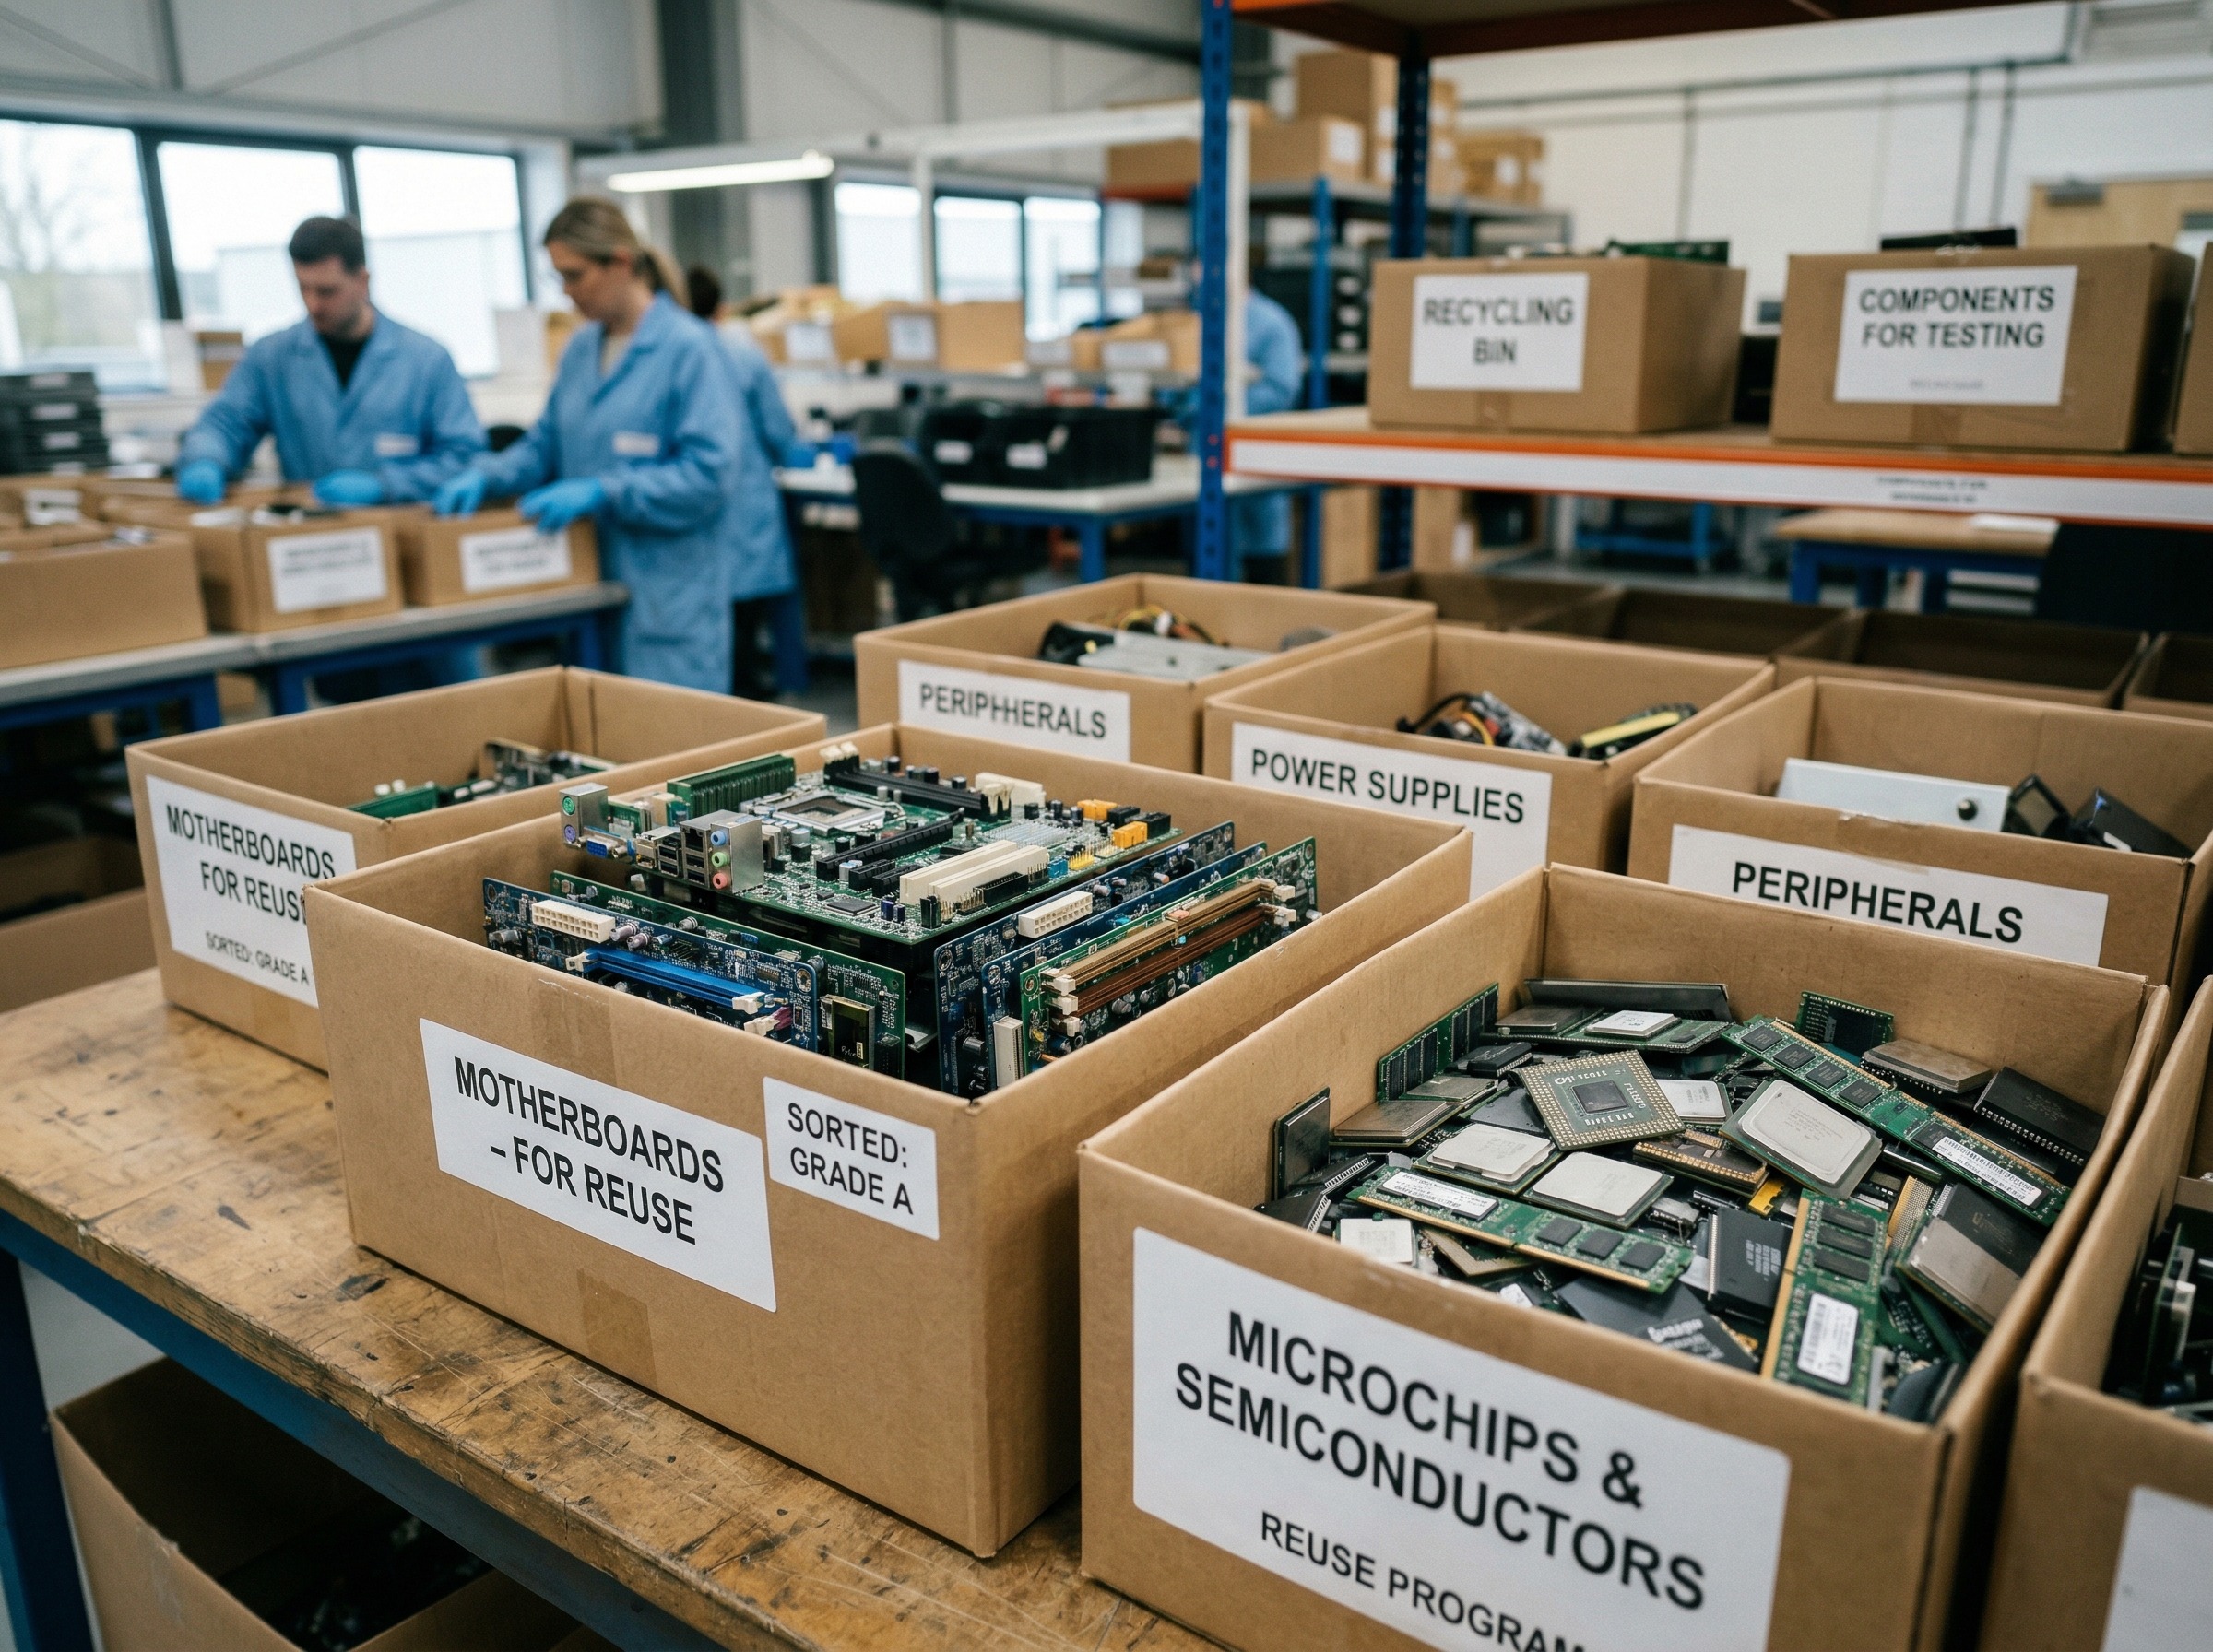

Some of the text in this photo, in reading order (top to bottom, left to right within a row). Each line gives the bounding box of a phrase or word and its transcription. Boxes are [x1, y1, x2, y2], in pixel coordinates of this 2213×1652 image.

[1423, 297, 1574, 326] RECYCLING
[1860, 286, 2055, 313] COMPONENTS
[1863, 323, 2045, 348] FOR TESTING
[1473, 338, 1517, 364] BIN
[1252, 749, 1523, 823] POWER SUPPLIES
[167, 804, 336, 879] MOTHERBOARDS
[200, 861, 307, 925] FOR REUS
[1733, 862, 2023, 943] PERIPHERALS
[206, 932, 310, 986] SORTED: GRADE A
[455, 1056, 724, 1193] MOTHERBOARDS
[788, 1103, 914, 1215] SORTED: GRADE A
[514, 1136, 577, 1197] FOR
[584, 1164, 696, 1245] REUSE
[1229, 1311, 1643, 1510] MICROCHIPS &
[1177, 1363, 1706, 1611] SEMICONDUCTORS
[1261, 1511, 1376, 1589] REUSE
